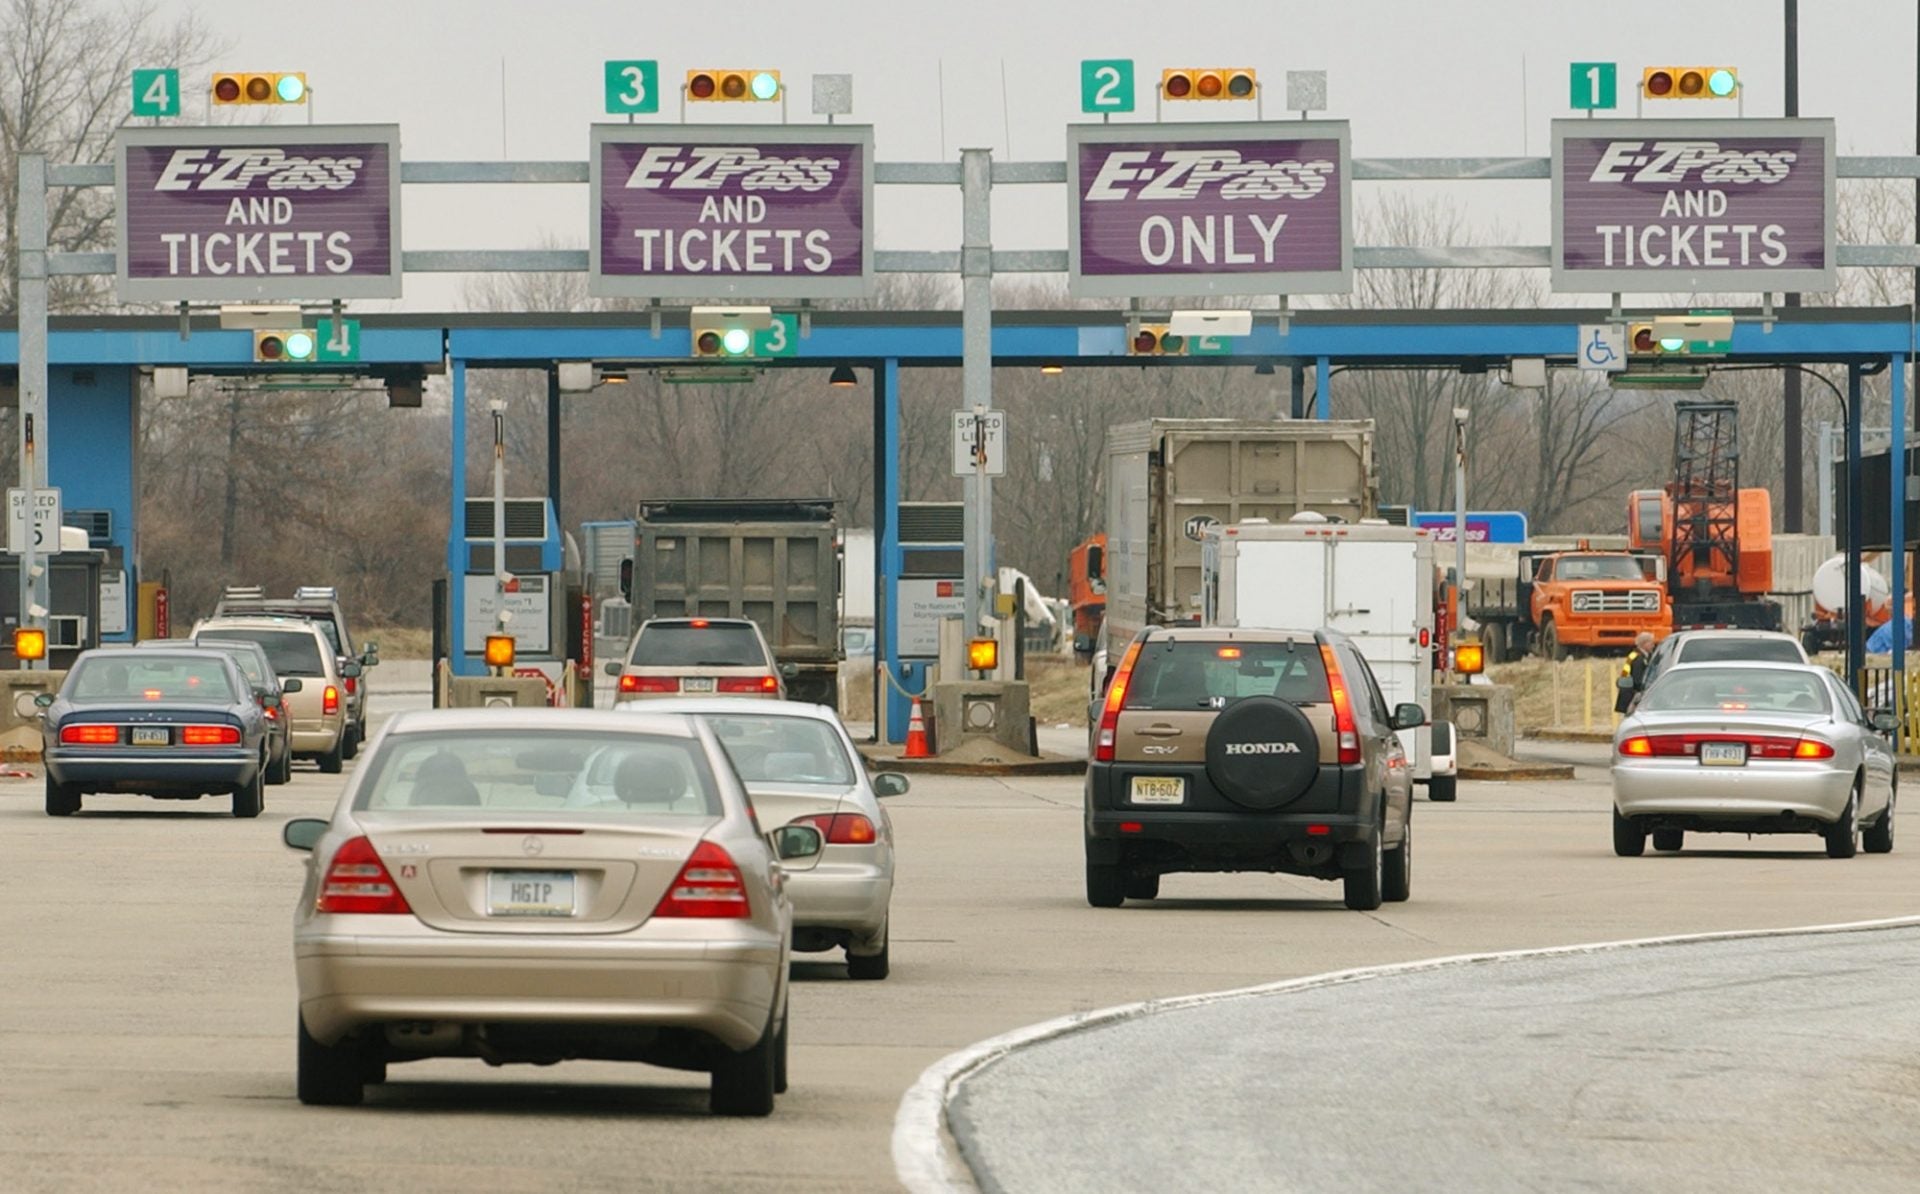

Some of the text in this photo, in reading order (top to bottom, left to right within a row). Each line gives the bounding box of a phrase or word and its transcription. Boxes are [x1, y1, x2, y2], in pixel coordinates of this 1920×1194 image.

[143, 74, 169, 111] 4
[619, 67, 645, 105] 3
[1094, 67, 1120, 105] 2
[1586, 66, 1600, 104] 1
[154, 149, 363, 191] E-ZPass
[625, 147, 840, 192] E-ZPass
[1084, 150, 1335, 200] E-ZPass
[1588, 141, 1797, 184] E-ZPass
[225, 196, 293, 225] AND
[698, 195, 766, 224] AND
[1659, 189, 1728, 218] AND
[160, 230, 354, 275] TICKETS
[634, 228, 833, 272] TICKETS
[1139, 214, 1288, 266] ONLY
[1595, 224, 1788, 267] TICKETS
[326, 324, 351, 357] 4
[765, 319, 786, 352] 3
[957, 417, 1001, 429] SPED
[1142, 745, 1179, 754] CR-V
[1225, 742, 1300, 754] HONDA
[511, 882, 552, 903] HGIP
